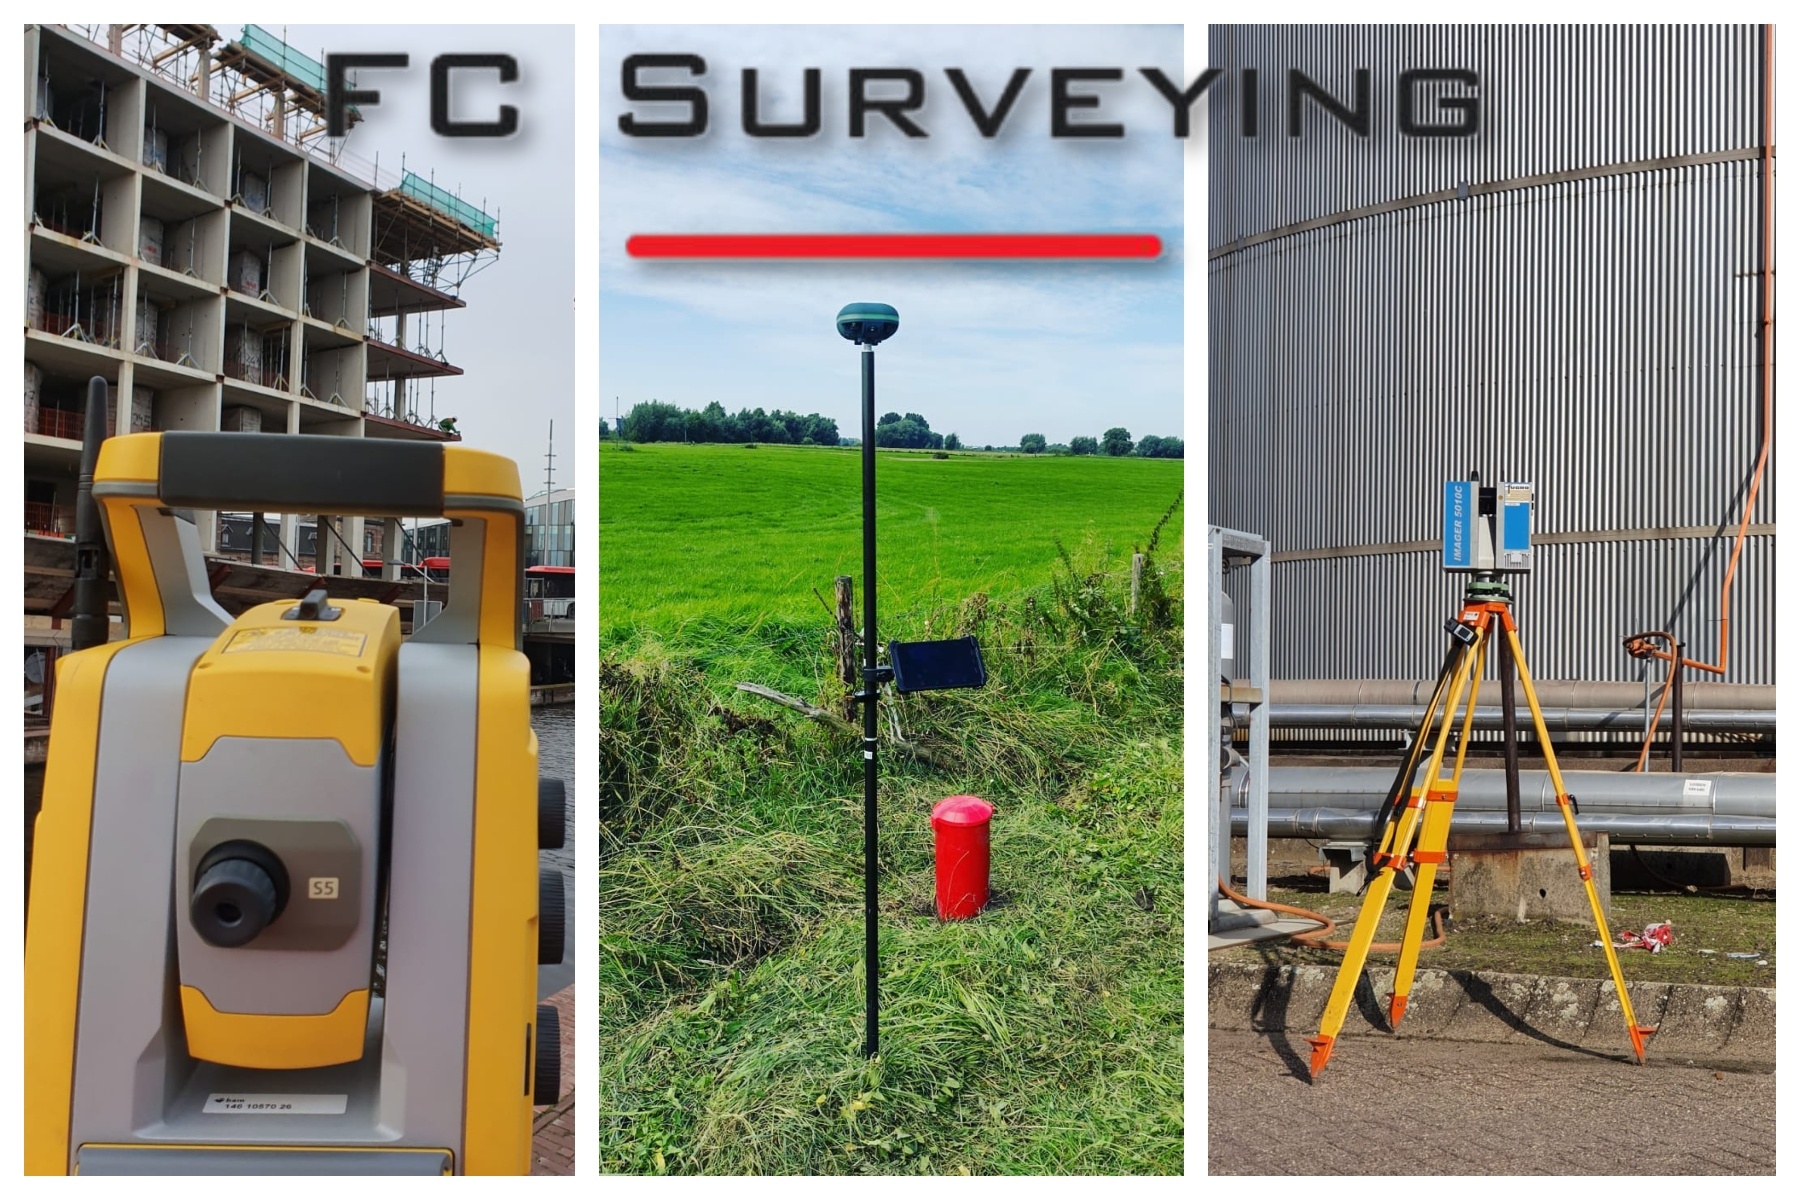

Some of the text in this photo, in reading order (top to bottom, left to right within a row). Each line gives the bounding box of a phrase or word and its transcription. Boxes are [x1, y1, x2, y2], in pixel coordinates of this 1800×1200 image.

[1453, 485, 1463, 562] IMAGER 5010C
[313, 881, 334, 895] S5
